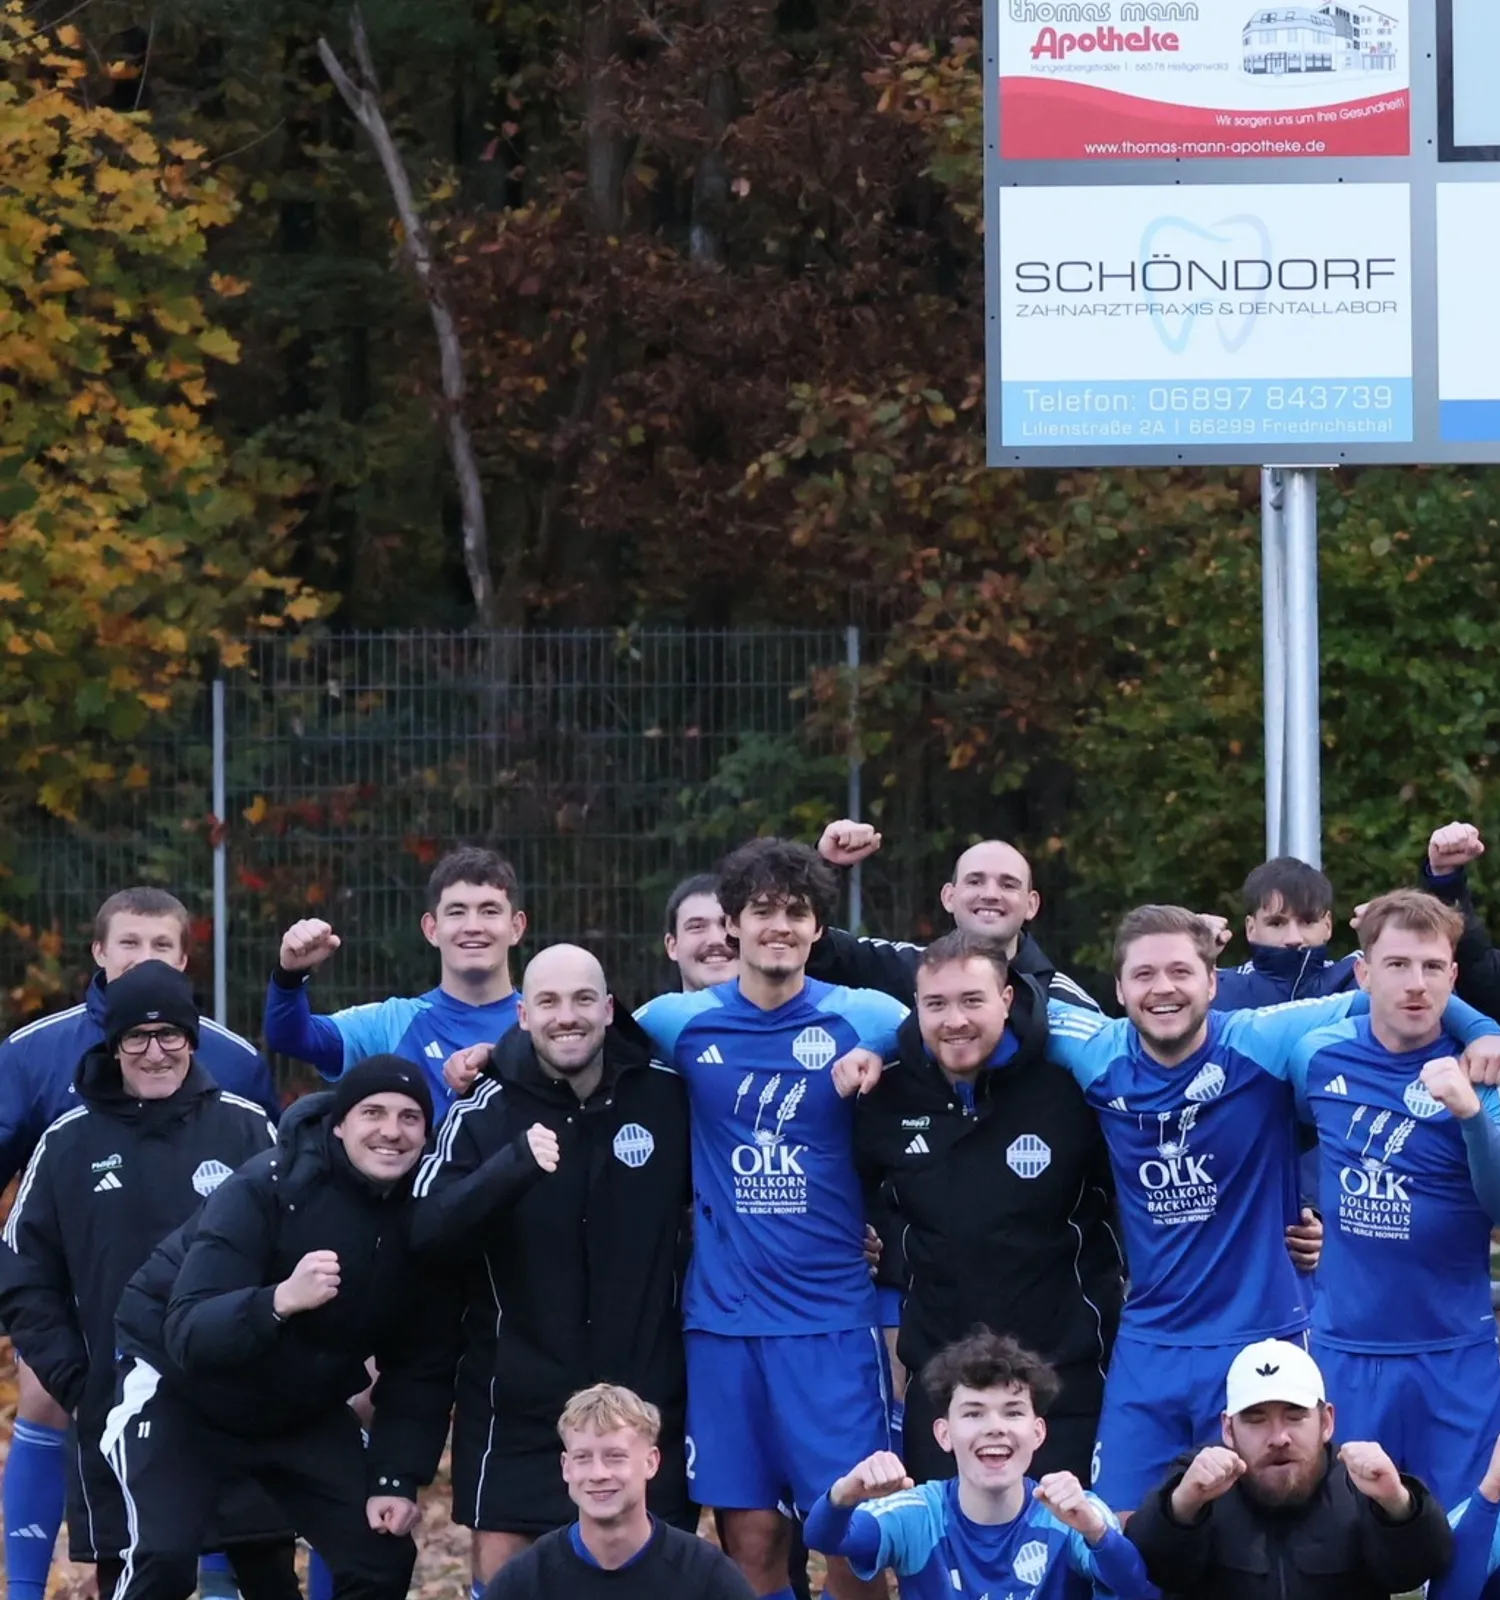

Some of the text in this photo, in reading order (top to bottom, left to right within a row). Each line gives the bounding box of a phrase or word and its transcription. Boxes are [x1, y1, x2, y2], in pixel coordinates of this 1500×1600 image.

[1008, 0, 1199, 22] thomas mann
[1030, 26, 1180, 60] Apotheke
[1135, 62, 1165, 72] 66578
[1216, 114, 1232, 126] Wir
[1234, 115, 1271, 128] sorgen
[1274, 114, 1293, 125] uns
[1295, 113, 1314, 124] um
[1317, 111, 1337, 122] Ihre
[1084, 139, 1326, 156] www.thomas-mann-apotheke.de
[1015, 253, 1397, 293] SCHÖNDORF
[1016, 300, 1398, 318] ZAHNARZTPRAXIS & DENTALLABOR
[1022, 385, 1393, 413] Telefon: 06897 843739
[1021, 419, 1133, 437] Lilienstraße
[1139, 418, 1166, 435] 2A
[1189, 416, 1256, 434] 66299
[1262, 416, 1393, 434] Friedrichsthal
[731, 1144, 805, 1175] OLK
[1139, 1154, 1213, 1190] OLK
[734, 1176, 807, 1188] VOLLKORN
[1146, 1183, 1217, 1200] VOLLKORN
[1340, 1166, 1410, 1201] OLK
[735, 1188, 807, 1200] BACKHAUS
[1341, 1194, 1412, 1213] VOLLKORN
[1147, 1195, 1217, 1213] BACKHAUS
[1339, 1206, 1411, 1226] BACKHAUS
